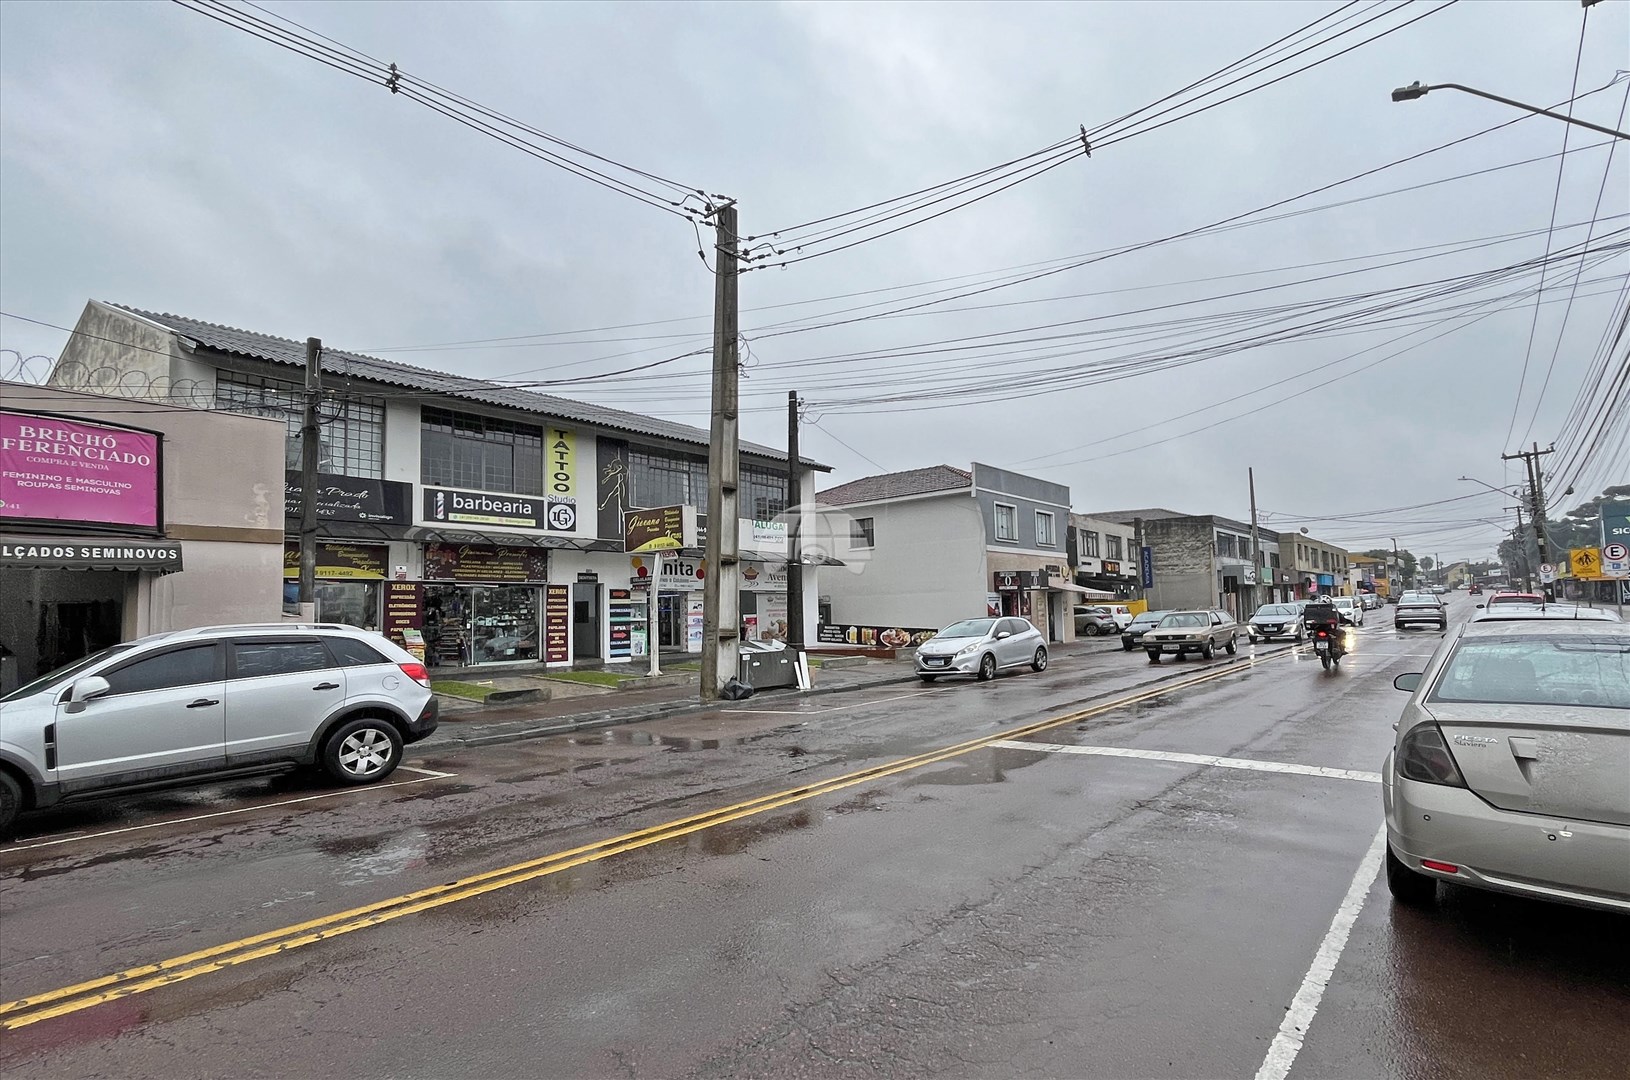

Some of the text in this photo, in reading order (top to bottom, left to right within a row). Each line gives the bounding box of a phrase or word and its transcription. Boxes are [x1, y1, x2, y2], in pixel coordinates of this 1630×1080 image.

[19, 426, 117, 449] BRECHÓ
[2, 438, 150, 466] FERENCIADO
[26, 456, 69, 466] COMPRA
[79, 461, 110, 471] VENDA
[553, 429, 570, 492] TATTOO
[2, 471, 62, 482] FEMININO
[76, 478, 132, 489] MASCULINO
[17, 480, 121, 495] ROUPAS SEMINOVAS
[453, 493, 532, 515] barbearia
[548, 493, 577, 504] Studio
[754, 520, 784, 531] ALUGA
[2, 546, 178, 560] LÇADOS SEMINOVOS
[1610, 546, 1620, 557] E
[655, 559, 694, 576] nita
[1453, 734, 1498, 744] FIESTA
